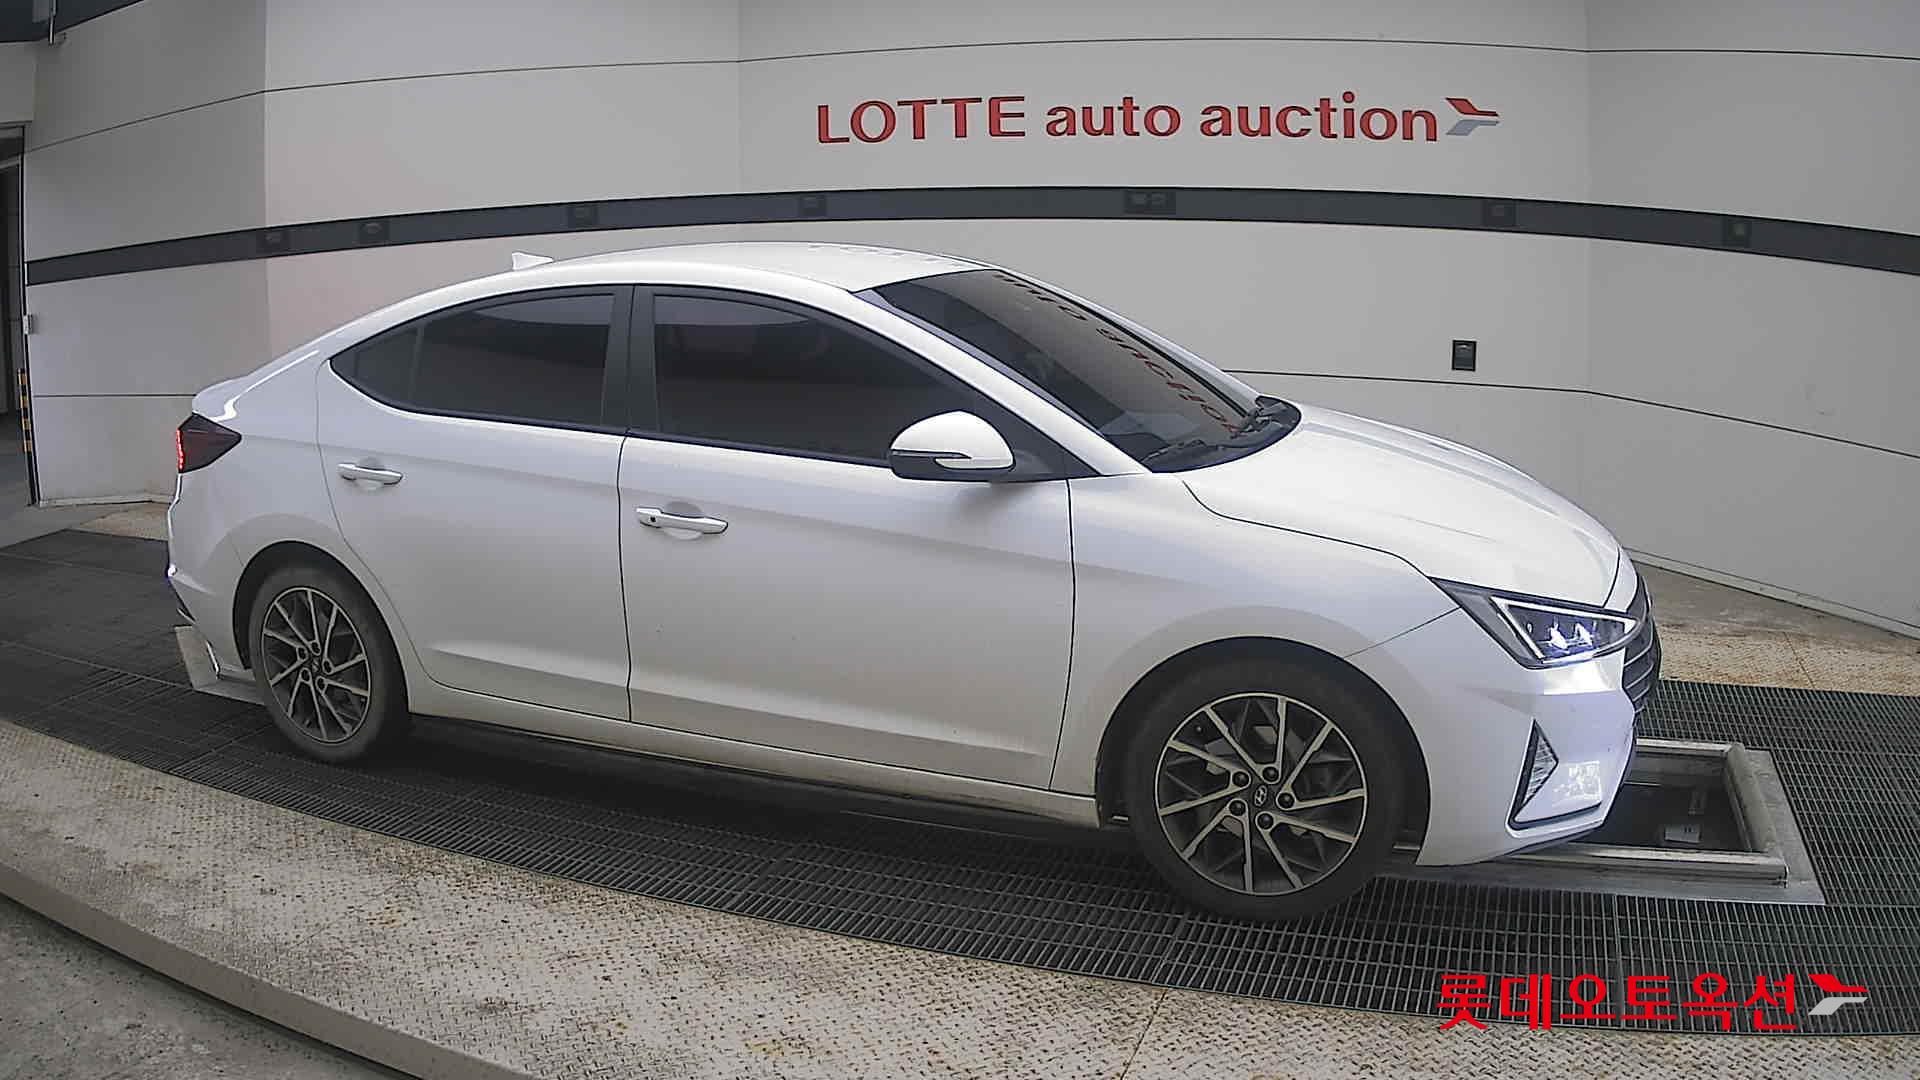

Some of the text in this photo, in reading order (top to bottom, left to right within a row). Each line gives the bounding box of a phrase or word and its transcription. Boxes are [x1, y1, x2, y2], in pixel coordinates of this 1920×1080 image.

[816, 91, 1439, 143] LOTTE auto auction
